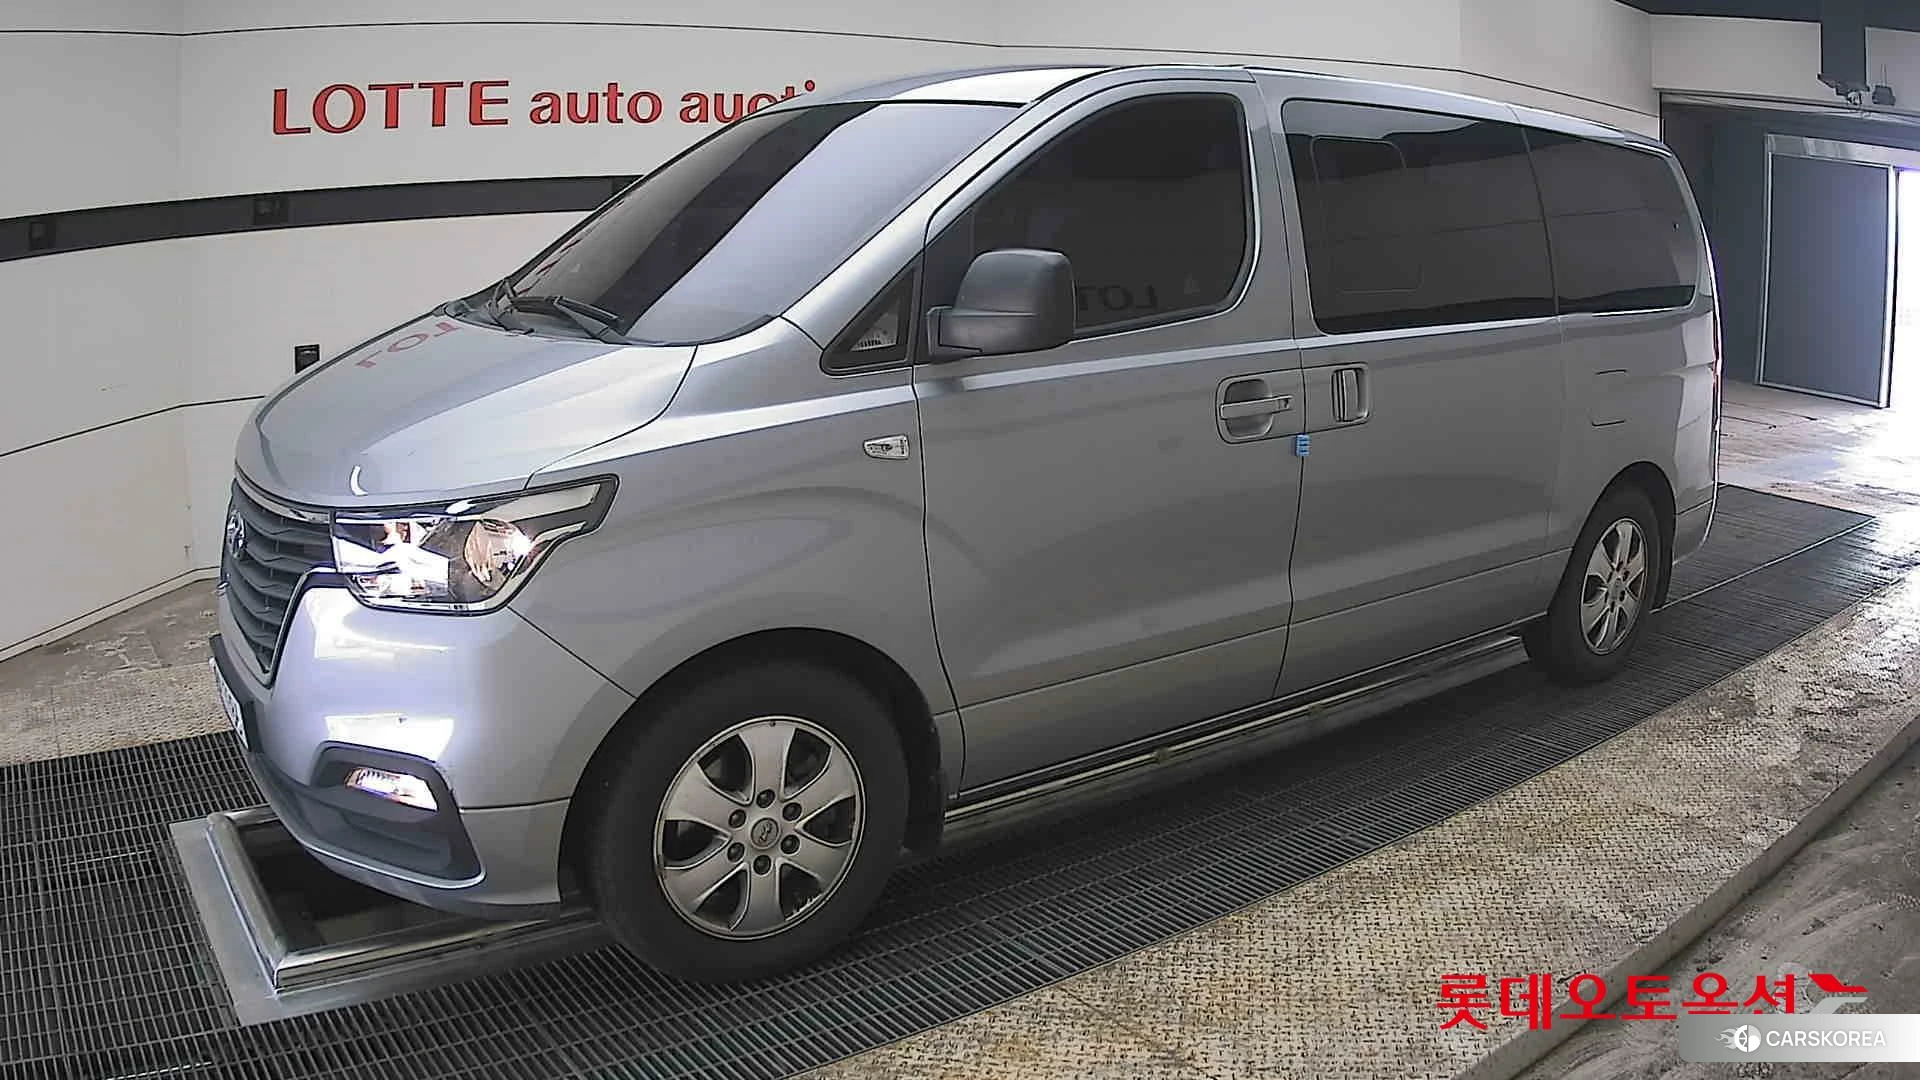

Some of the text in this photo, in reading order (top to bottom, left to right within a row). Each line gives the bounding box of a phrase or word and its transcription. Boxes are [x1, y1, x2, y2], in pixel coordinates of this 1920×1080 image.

[273, 79, 816, 135] LOTTE auto auc
